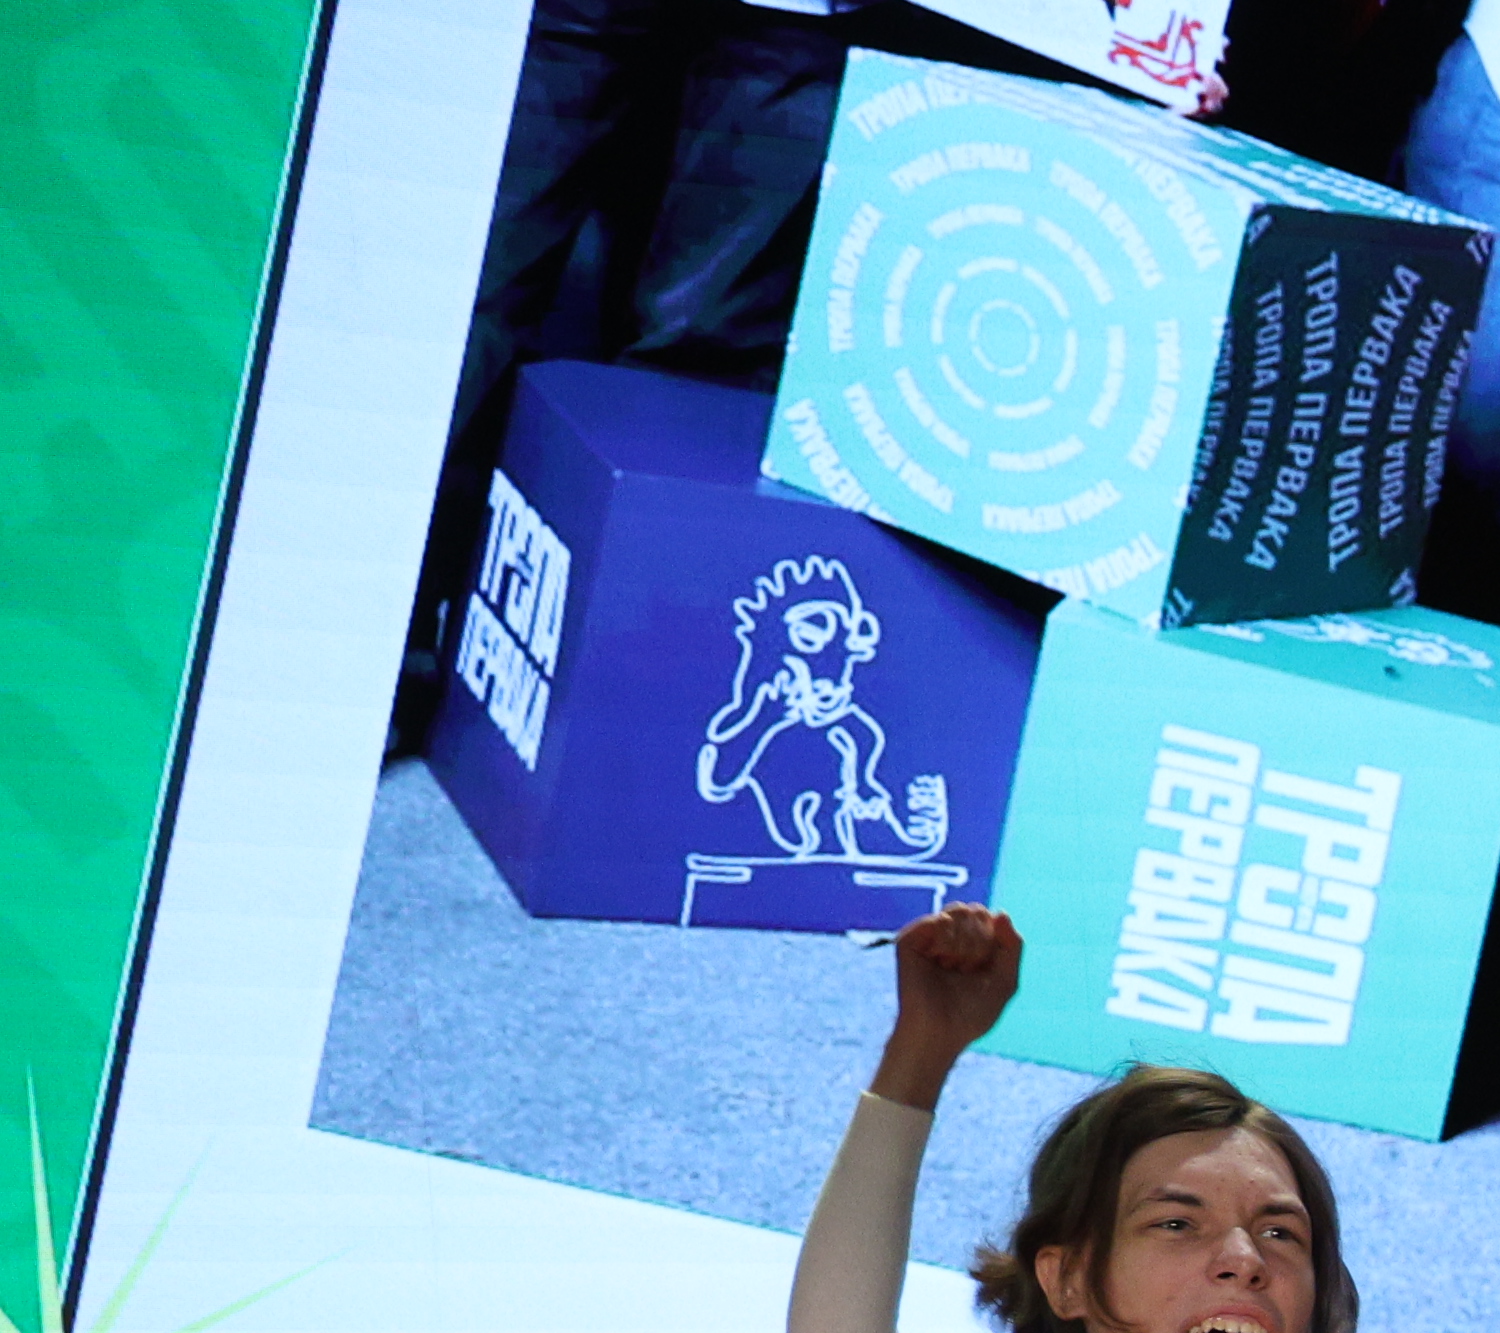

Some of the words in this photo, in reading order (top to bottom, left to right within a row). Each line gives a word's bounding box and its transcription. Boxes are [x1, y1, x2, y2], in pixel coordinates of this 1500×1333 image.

[1251, 280, 1285, 389] ТРОПА
[1301, 250, 1339, 383] ТРОПА
[1338, 264, 1424, 437] ПЕРВАКА
[1388, 299, 1454, 433] ПЕРВАКА
[1207, 394, 1275, 542] ПЕРВАКА
[1244, 391, 1329, 571] ПЕРВАКА
[1327, 445, 1366, 573] ТРОПА
[479, 468, 572, 679] ТРОПА
[1104, 723, 1262, 1033] ПЕРВАКА
[1210, 763, 1402, 1047] ТРОПА
